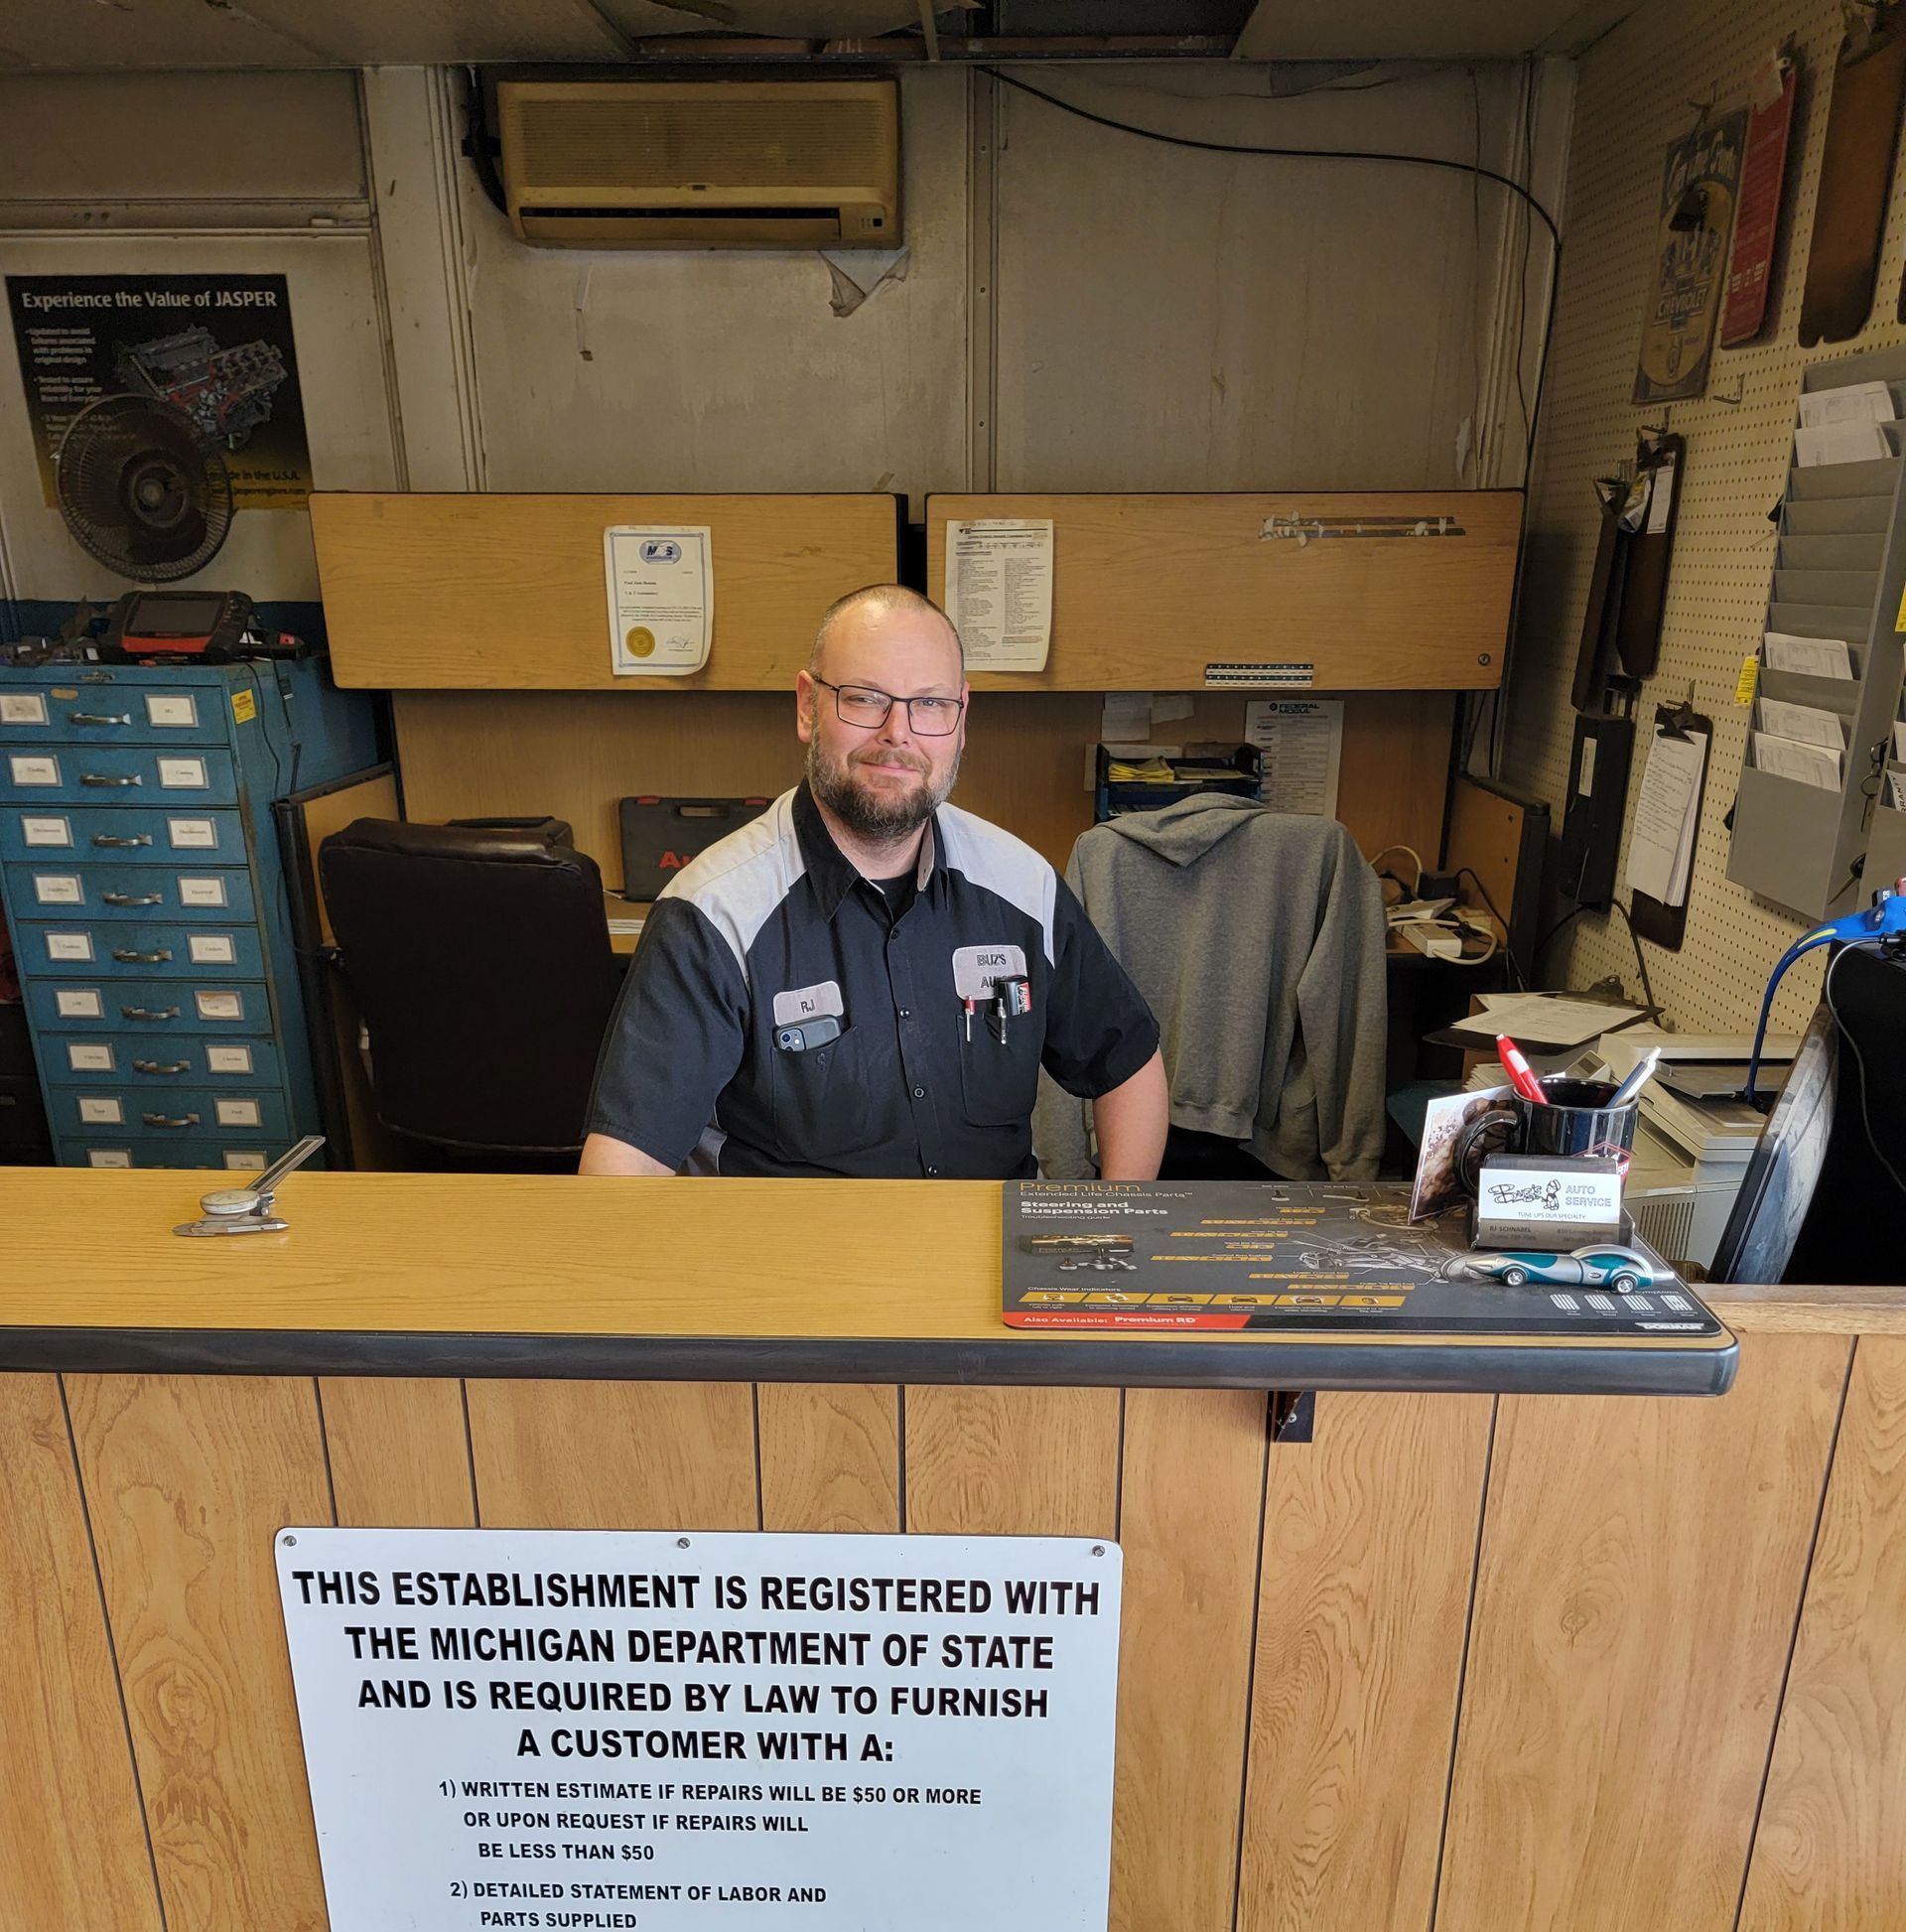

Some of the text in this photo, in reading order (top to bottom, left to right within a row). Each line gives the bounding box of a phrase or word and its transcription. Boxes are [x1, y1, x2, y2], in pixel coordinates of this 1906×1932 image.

[22, 291, 277, 312] Experience the Value of JASPER
[800, 1000, 815, 1013] RJ
[1020, 1182, 1141, 1192] Premium
[1565, 1184, 1596, 1196] AUTO
[1020, 1201, 1093, 1209] Steering
[1565, 1196, 1612, 1208] SERVICE
[291, 1571, 1099, 1615] THIS ESTABLISHMENT IS REGISTERED WITH
[343, 1626, 1053, 1670] THE MICHIGAN DEPARTMENT OF STATE
[357, 1679, 1047, 1719] AND IS REQUIRED BY LAW TO FURNISH
[516, 1728, 893, 1762] A CUSTOMER WITH A:
[439, 1778, 982, 1805] 1) WRITTEN ESTIMATE IF REPAIRS WILL BE $50 OR MORE
[464, 1811, 809, 1832] OR UPON REQUEST IF REPAIRS WILL
[477, 1843, 654, 1862] BE LESS THAN $50
[450, 1880, 827, 1903] 2) DETAILED STATEMENT OF LABOR AND
[480, 1911, 637, 1929] PARTS SUPPLIED
